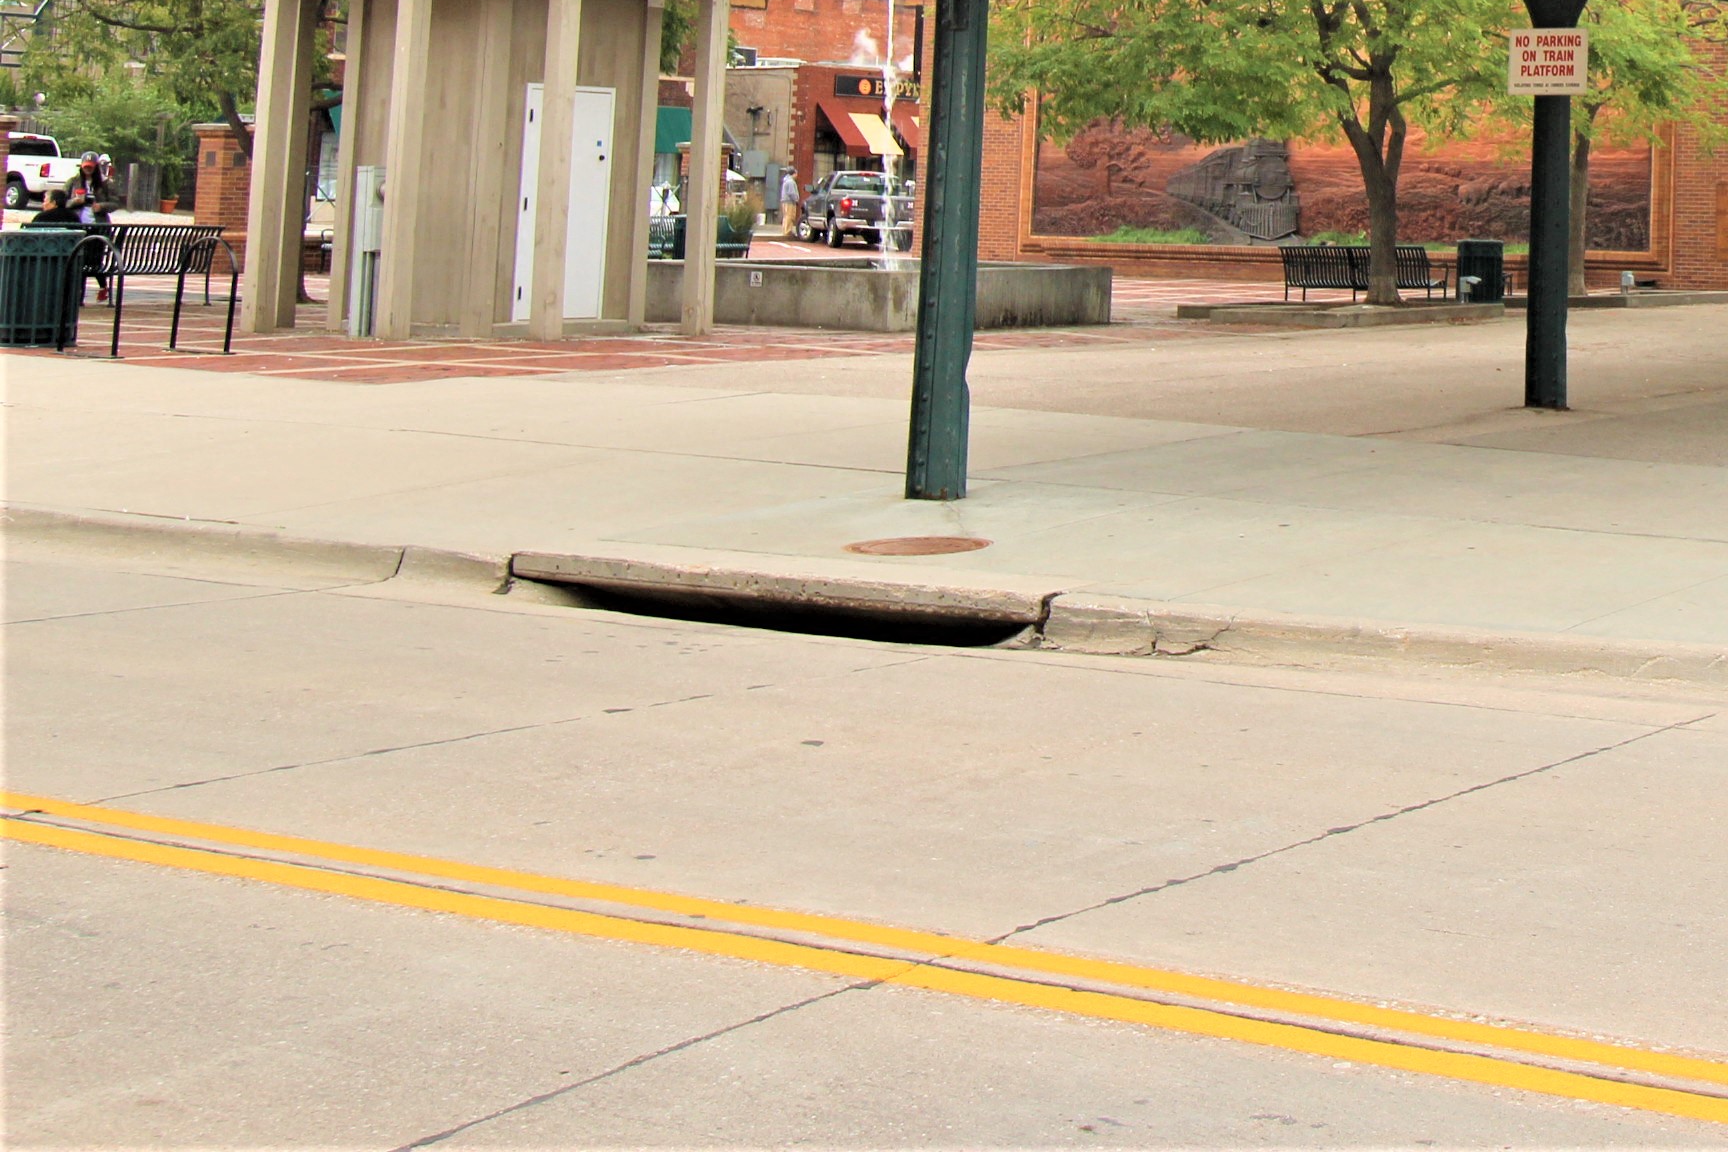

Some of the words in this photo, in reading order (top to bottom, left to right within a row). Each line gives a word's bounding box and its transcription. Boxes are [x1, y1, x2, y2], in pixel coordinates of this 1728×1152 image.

[1516, 35, 1530, 47] NO
[1536, 35, 1582, 47] PARKING
[1522, 50, 1537, 62] ON
[1543, 50, 1574, 62] TRAIN
[1520, 65, 1575, 77] PLATFORM
